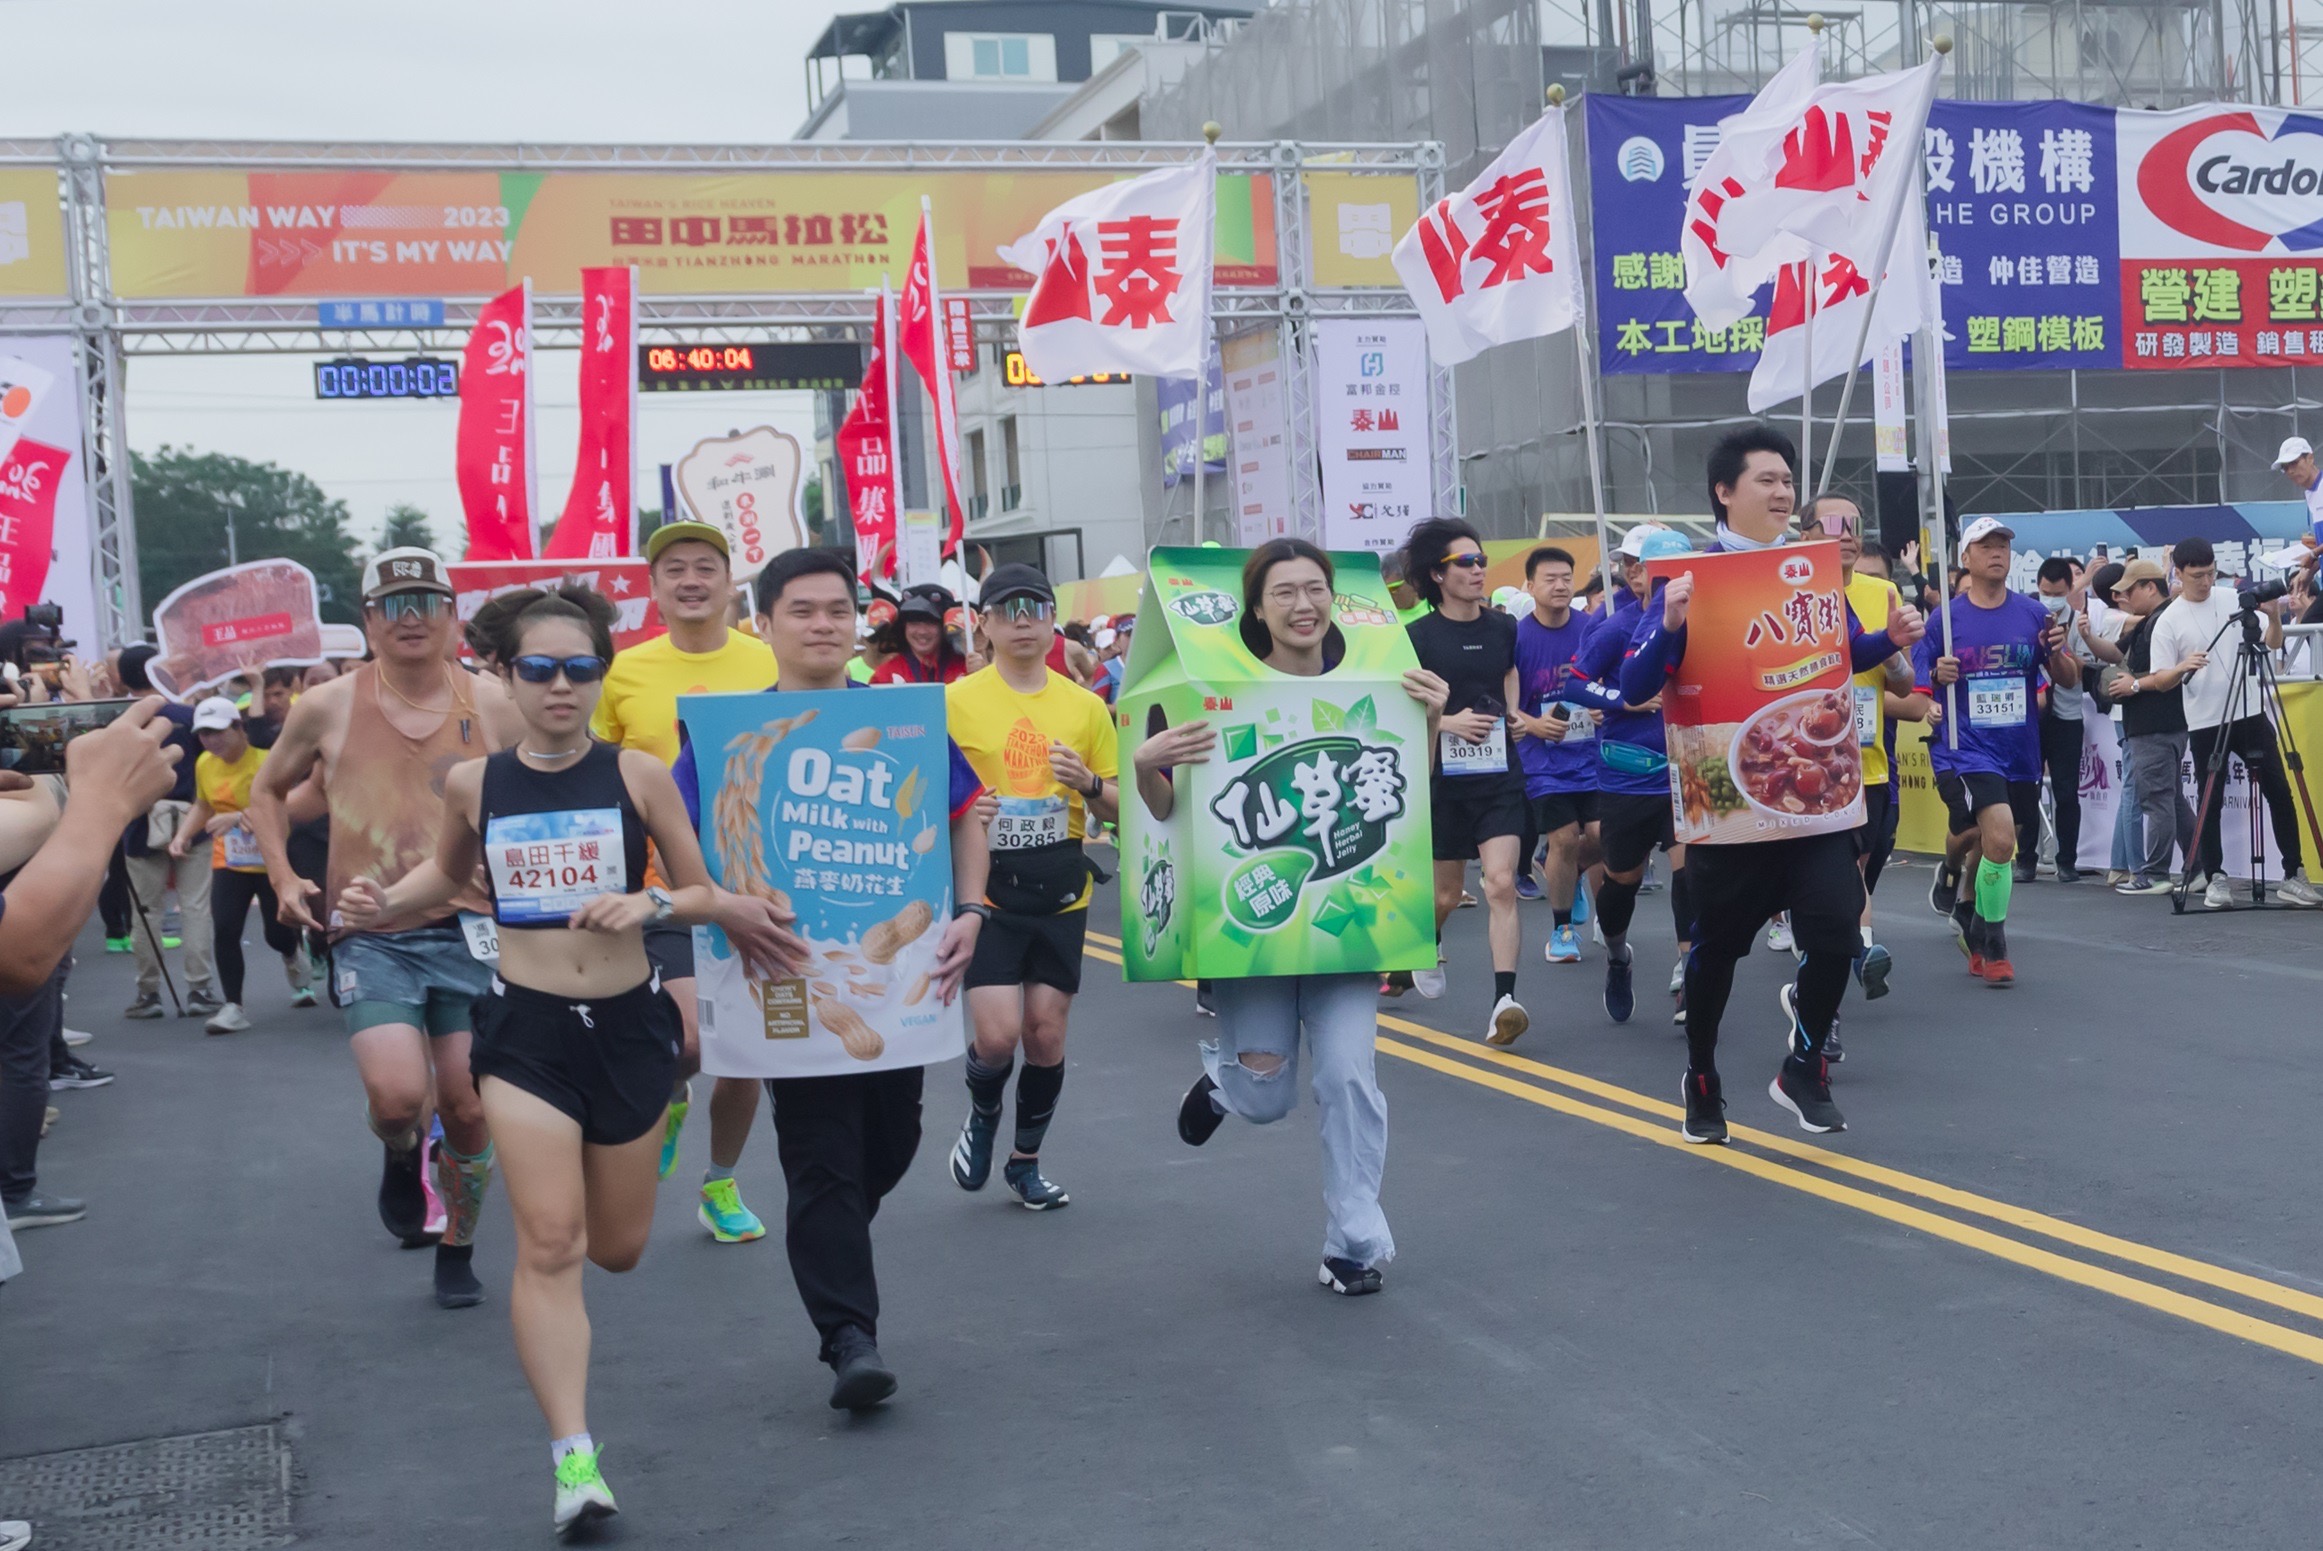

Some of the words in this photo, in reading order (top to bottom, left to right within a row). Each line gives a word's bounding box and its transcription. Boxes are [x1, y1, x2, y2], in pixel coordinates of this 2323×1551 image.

[2197, 155, 2323, 196] Cardo
[137, 206, 259, 228] TAIWAN
[267, 206, 335, 227] WAY
[443, 206, 510, 228] 2023
[1937, 203, 1973, 224] HE
[1990, 203, 2095, 224] GROUP
[610, 213, 888, 246] 田中馬拉松
[332, 240, 388, 263] IT'S
[396, 240, 440, 262] MY
[447, 239, 513, 262] WAY
[1989, 255, 2100, 286] 仲佳營造
[2141, 267, 2241, 321] 營建
[2270, 267, 2323, 320] 塑
[1967, 315, 2104, 353] 塑鋼模板
[2135, 331, 2239, 357] 研發製造
[649, 347, 753, 371] 06:40:04
[1351, 408, 1399, 431] 泰山
[1784, 562, 1811, 579] 泰山
[1747, 591, 1842, 646] 八寶粥
[1203, 696, 1233, 711] 泰山
[1976, 702, 2015, 714] 33151
[1449, 746, 1493, 759] 30319
[1897, 752, 1917, 768] AN'S
[788, 747, 894, 809] Oat
[1899, 775, 1927, 790] HONG
[782, 801, 849, 830] Milk
[852, 817, 889, 834] with
[1214, 750, 1403, 868] 仙草蜜
[1333, 821, 1361, 840] Honey
[1758, 816, 1811, 828] MIXED
[788, 829, 910, 871] Peanut
[997, 832, 1056, 848] 30285
[1334, 832, 1363, 850] Herbal
[1336, 844, 1357, 860] Jelly
[509, 865, 598, 889] 42104
[793, 867, 905, 896] 燕麥奶花生
[1233, 863, 1277, 902] 經典
[1248, 878, 1294, 919] 原味
[900, 1014, 937, 1027] VEGAN
